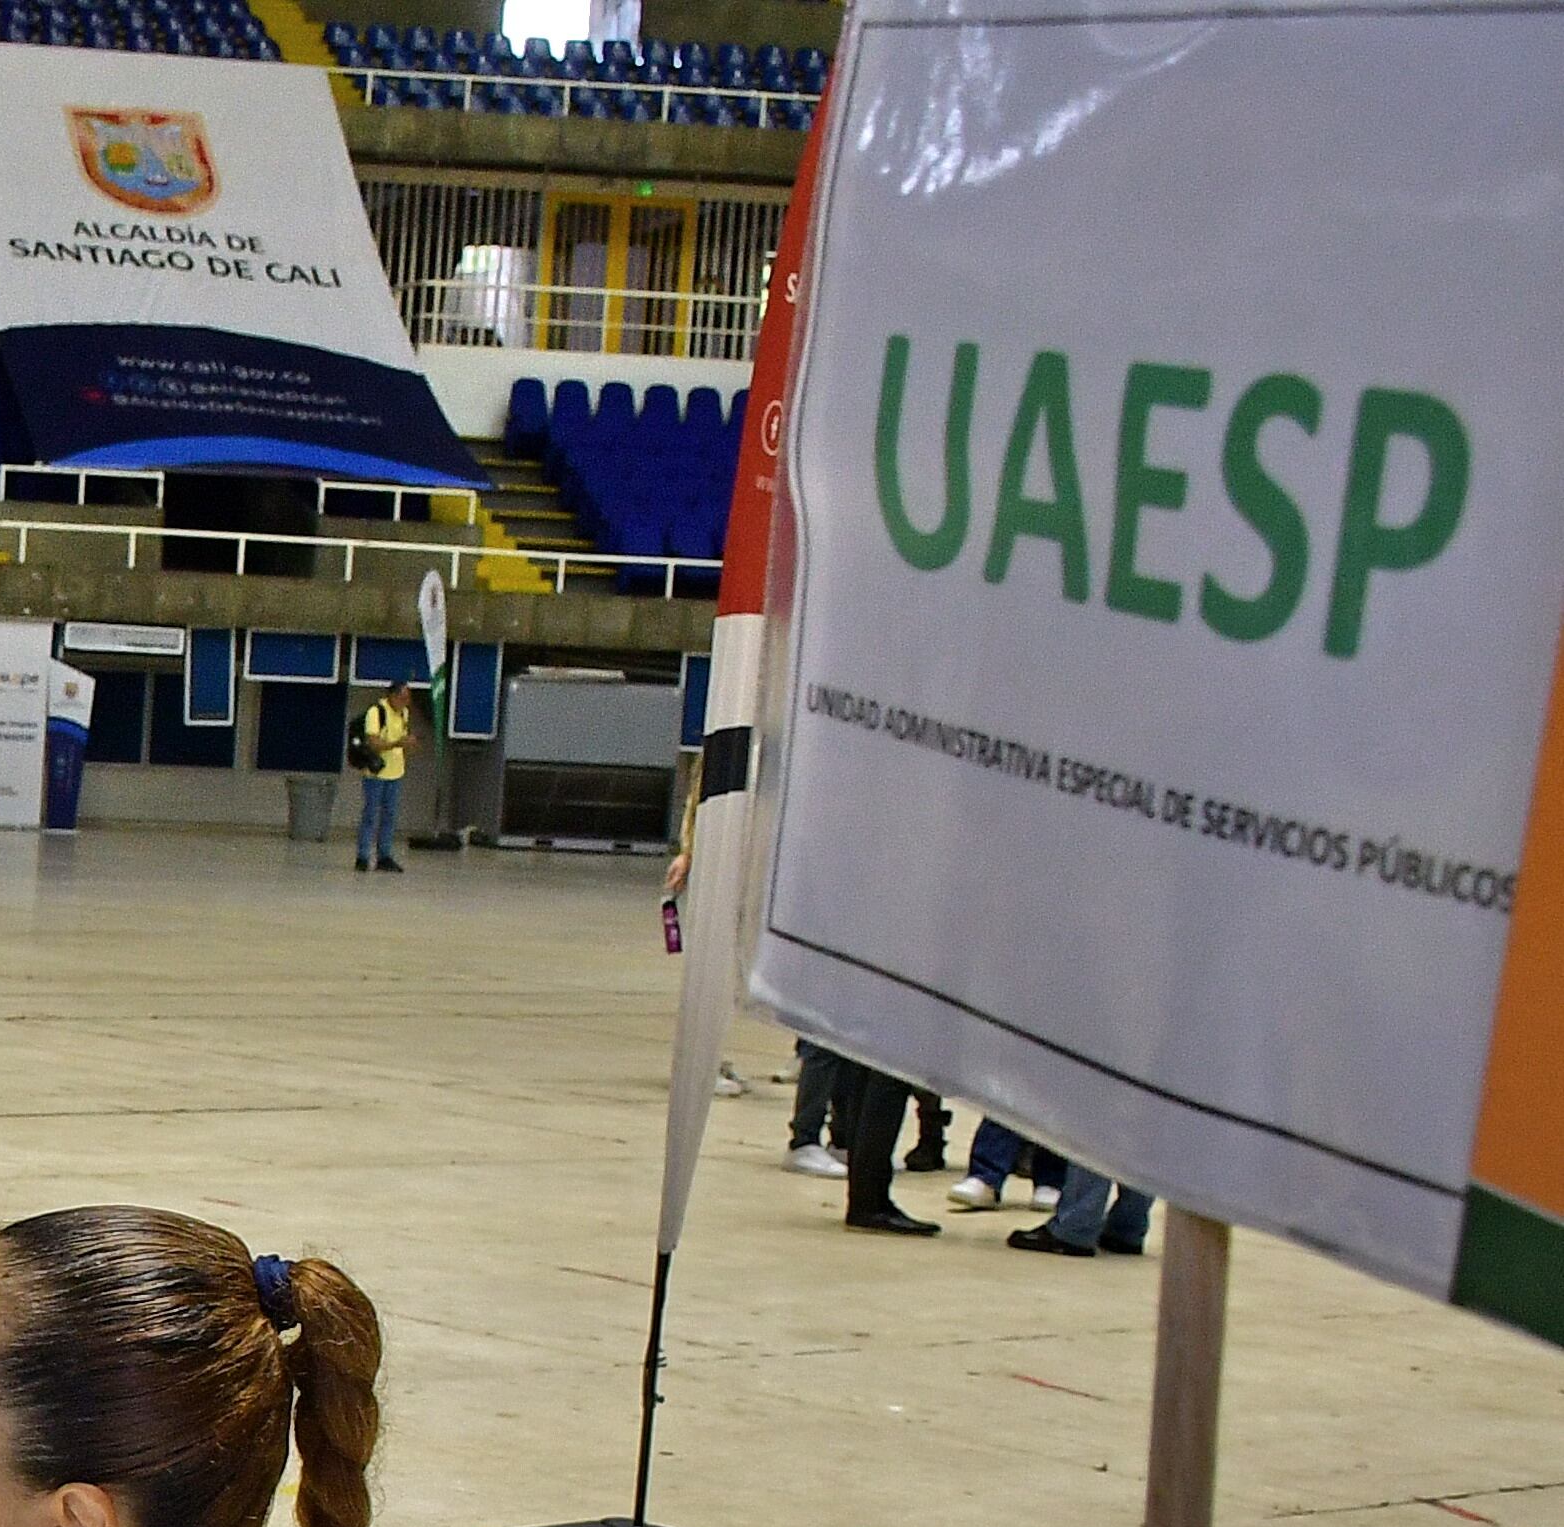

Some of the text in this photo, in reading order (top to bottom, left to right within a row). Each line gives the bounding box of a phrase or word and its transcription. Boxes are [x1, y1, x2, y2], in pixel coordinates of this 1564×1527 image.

[9, 238, 342, 289] SANTIAGO DE CALI
[73, 220, 264, 254] ALCALDÍA DE
[873, 333, 1471, 661] UAESP
[806, 681, 1520, 915] UNIDAD ADMINISTRATIVA ESPECIAL DE SERVICIOS PÚBLICOS
